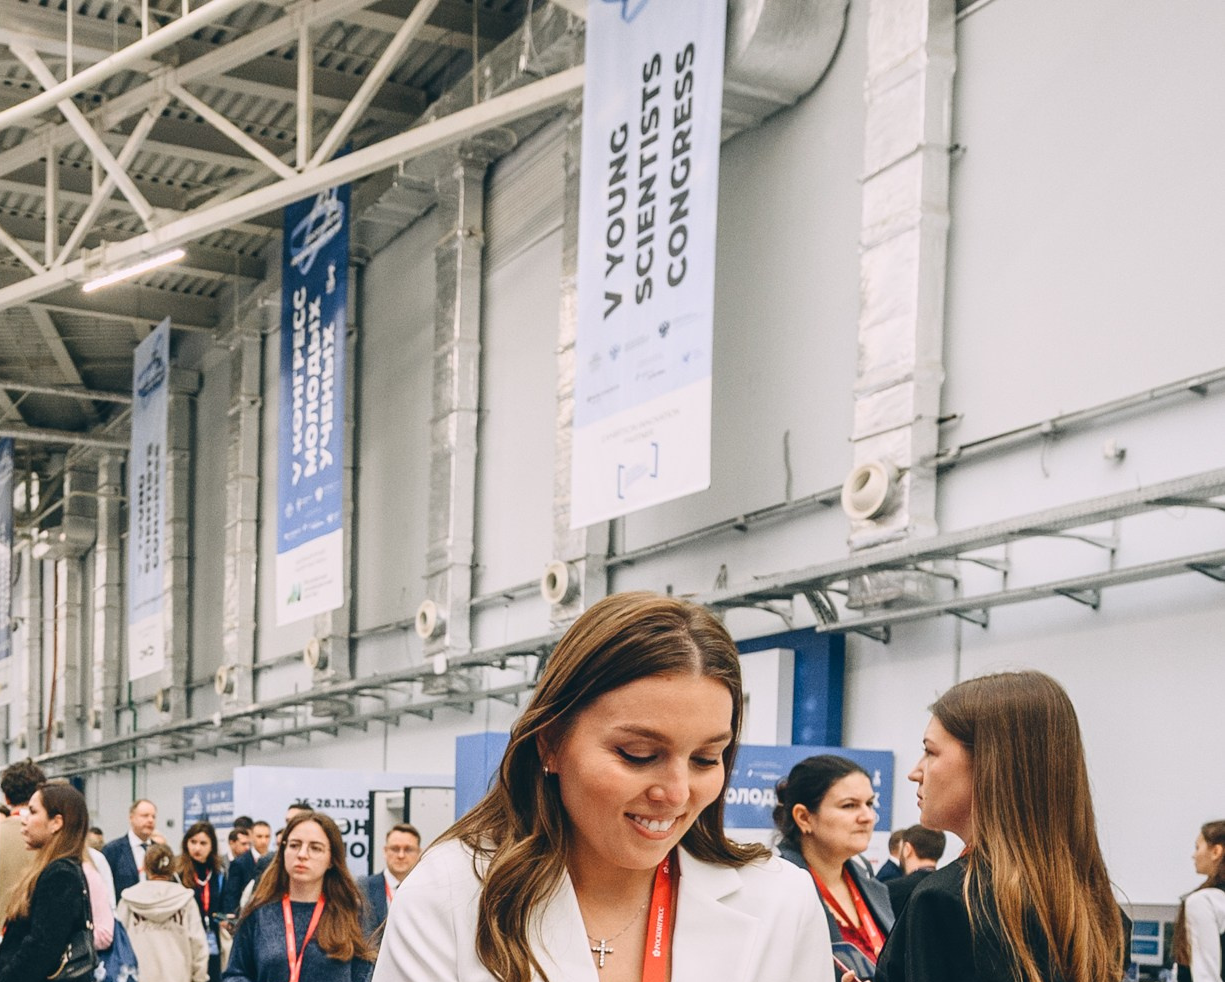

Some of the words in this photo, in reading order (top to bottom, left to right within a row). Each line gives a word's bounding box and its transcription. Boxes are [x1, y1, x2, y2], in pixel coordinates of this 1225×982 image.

[605, 121, 629, 280] YOUNG
[635, 52, 662, 305] SCIENTISTS
[667, 41, 695, 288] CONGRESS
[292, 286, 306, 456] КОНГРЕСС
[304, 295, 321, 480] МОЛОДЫХ
[603, 290, 623, 321] V
[319, 322, 335, 472] УЧЕНЫХ
[725, 787, 778, 808] ОЛОД
